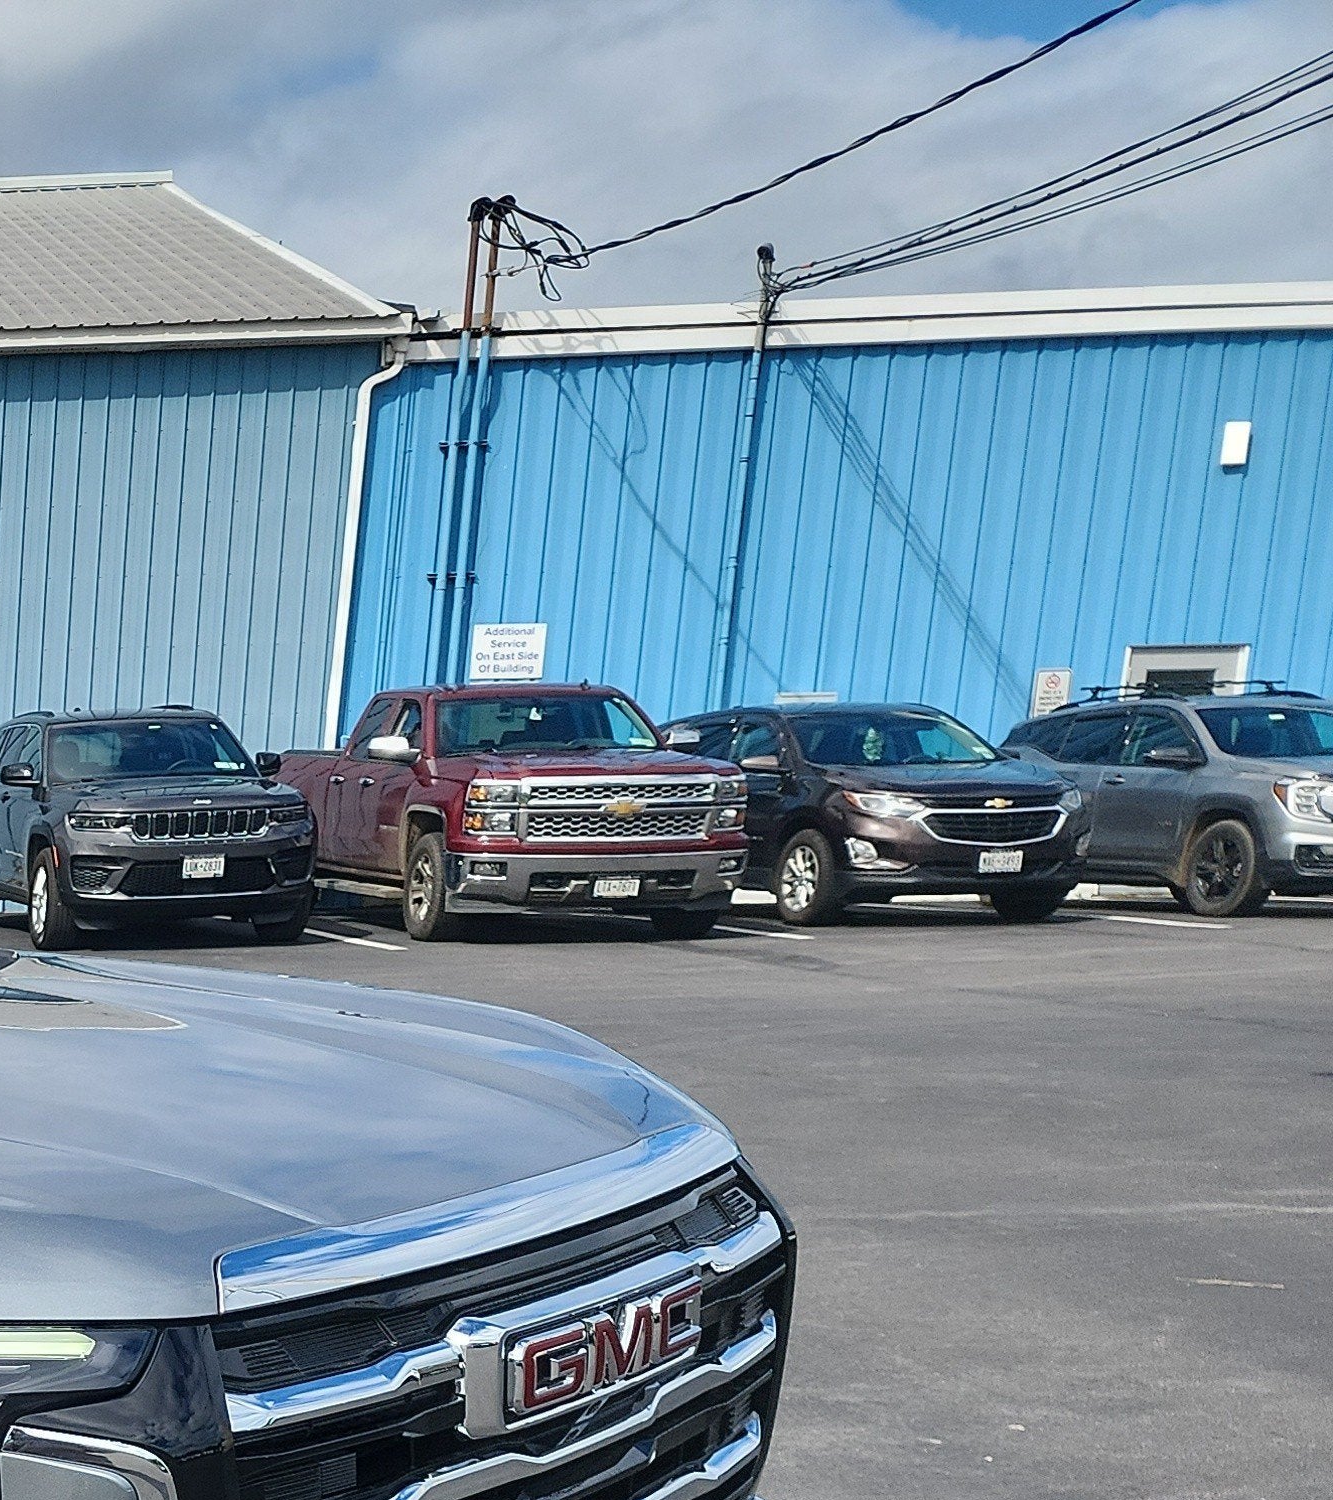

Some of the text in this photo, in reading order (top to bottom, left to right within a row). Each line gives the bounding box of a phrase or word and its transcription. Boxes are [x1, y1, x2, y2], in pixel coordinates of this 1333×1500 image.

[484, 627, 536, 636] Additional
[490, 640, 527, 648] Service
[476, 652, 539, 661] On East Side
[478, 664, 534, 674] Of Building
[508, 1275, 703, 1416] GMC
